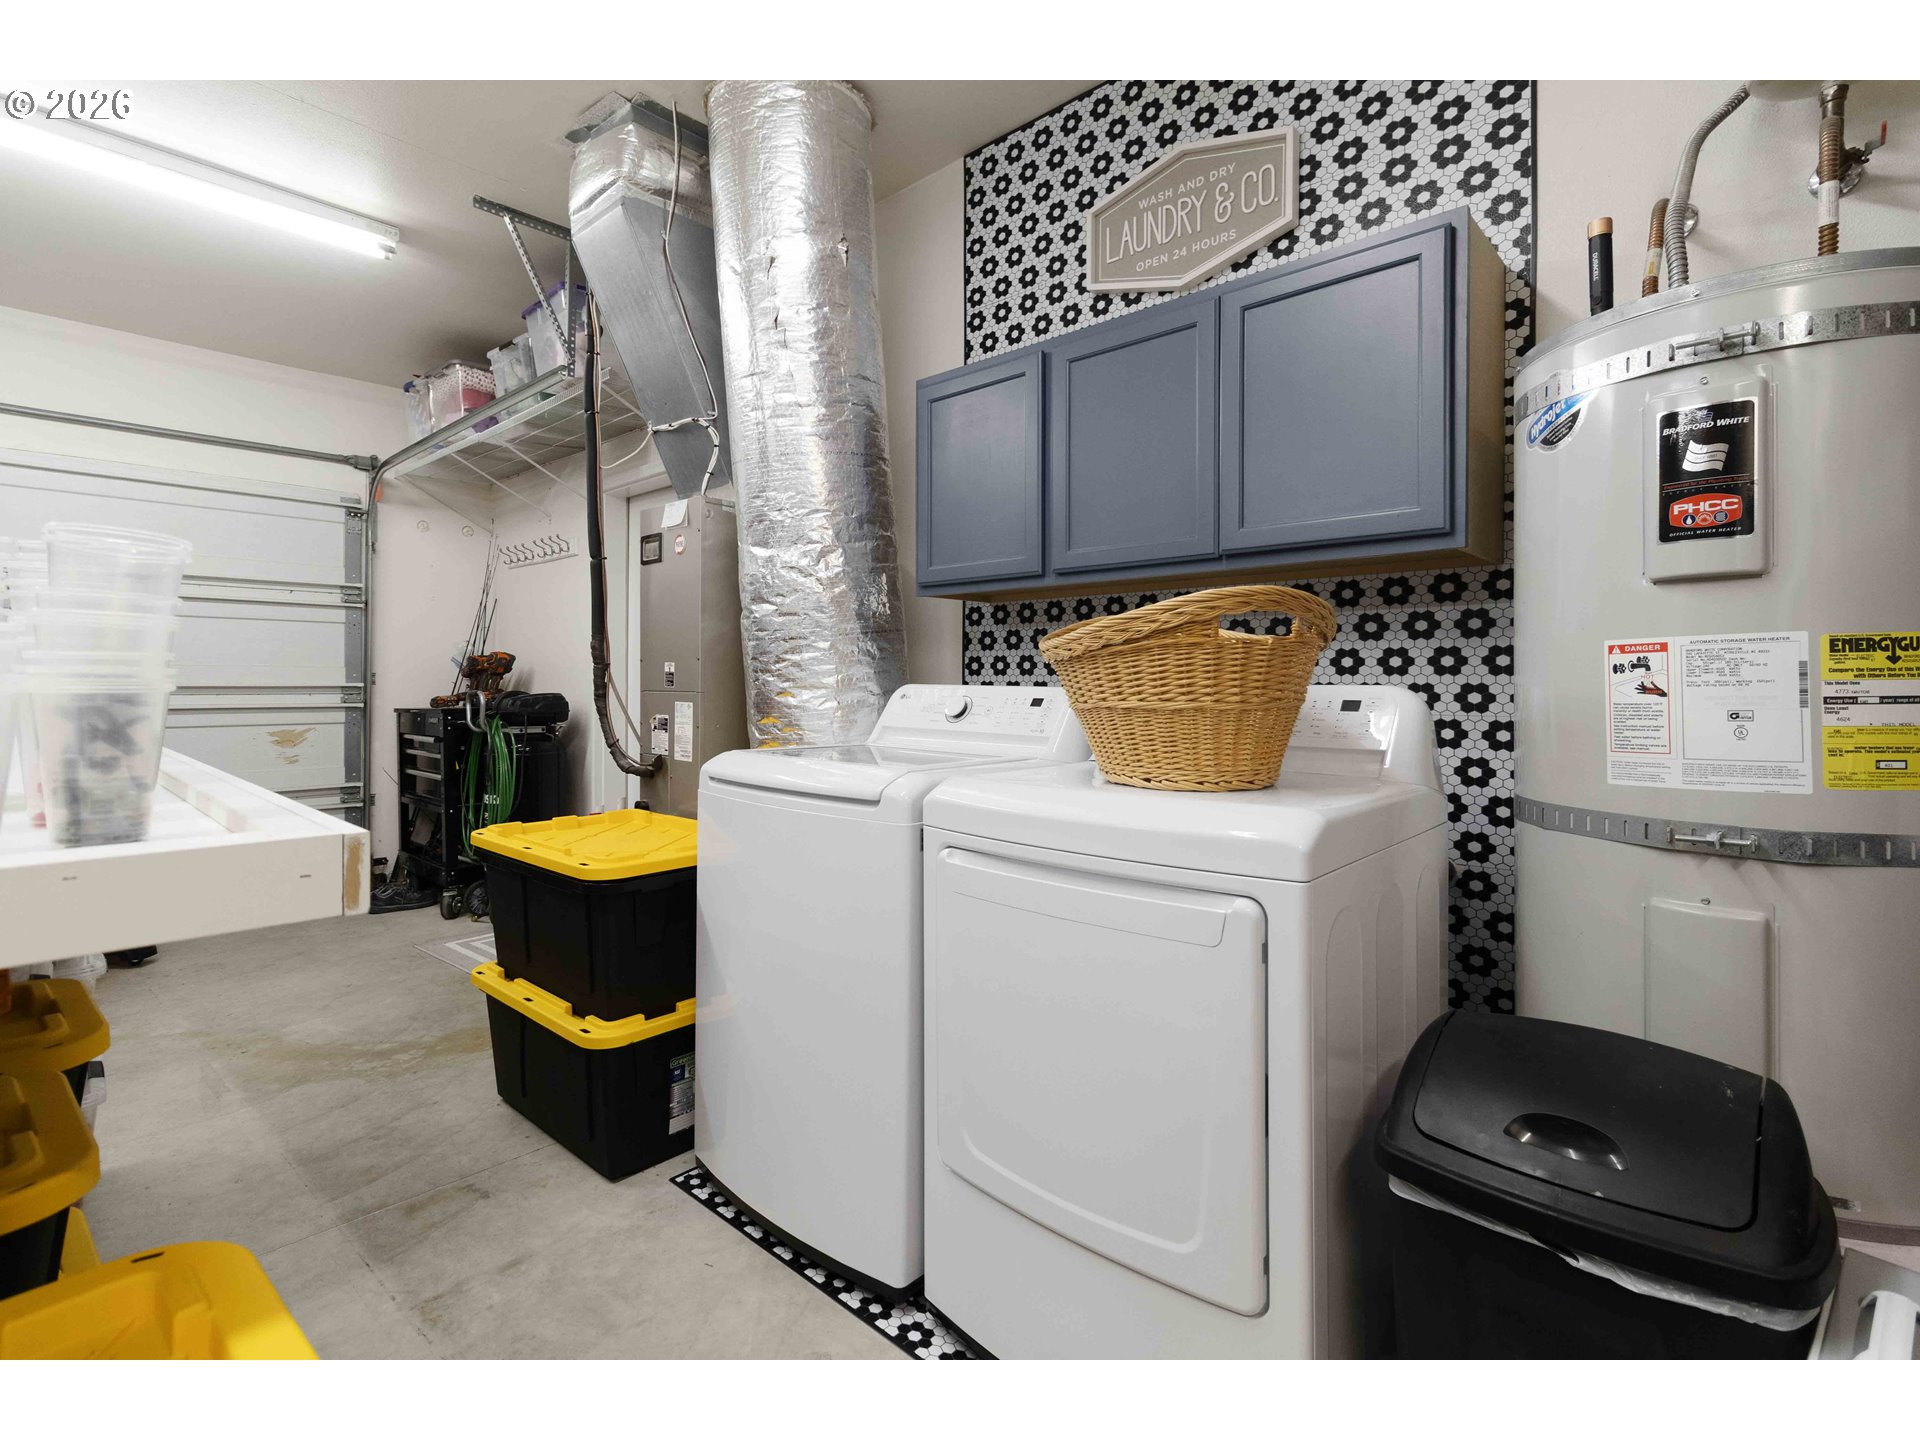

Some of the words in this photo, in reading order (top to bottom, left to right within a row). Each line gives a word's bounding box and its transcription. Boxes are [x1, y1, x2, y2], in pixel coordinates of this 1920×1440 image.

[1138, 188, 1172, 210] WASH
[1177, 176, 1204, 195] AND
[1209, 162, 1236, 182] DRY
[1106, 190, 1207, 263] LAUNDRY
[1214, 182, 1234, 223] &
[1240, 163, 1279, 214] CO.
[1135, 254, 1168, 272] OPEN
[1172, 246, 1187, 260] 24
[1192, 229, 1237, 253] HOURS
[1530, 400, 1566, 440] Hydrojet
[1662, 421, 1715, 436] BRADFORD
[1716, 416, 1751, 427] WHITE
[1673, 498, 1739, 515] PHCC
[1625, 644, 1661, 652] DANGER
[1829, 635, 1920, 655] ENERGYGU
